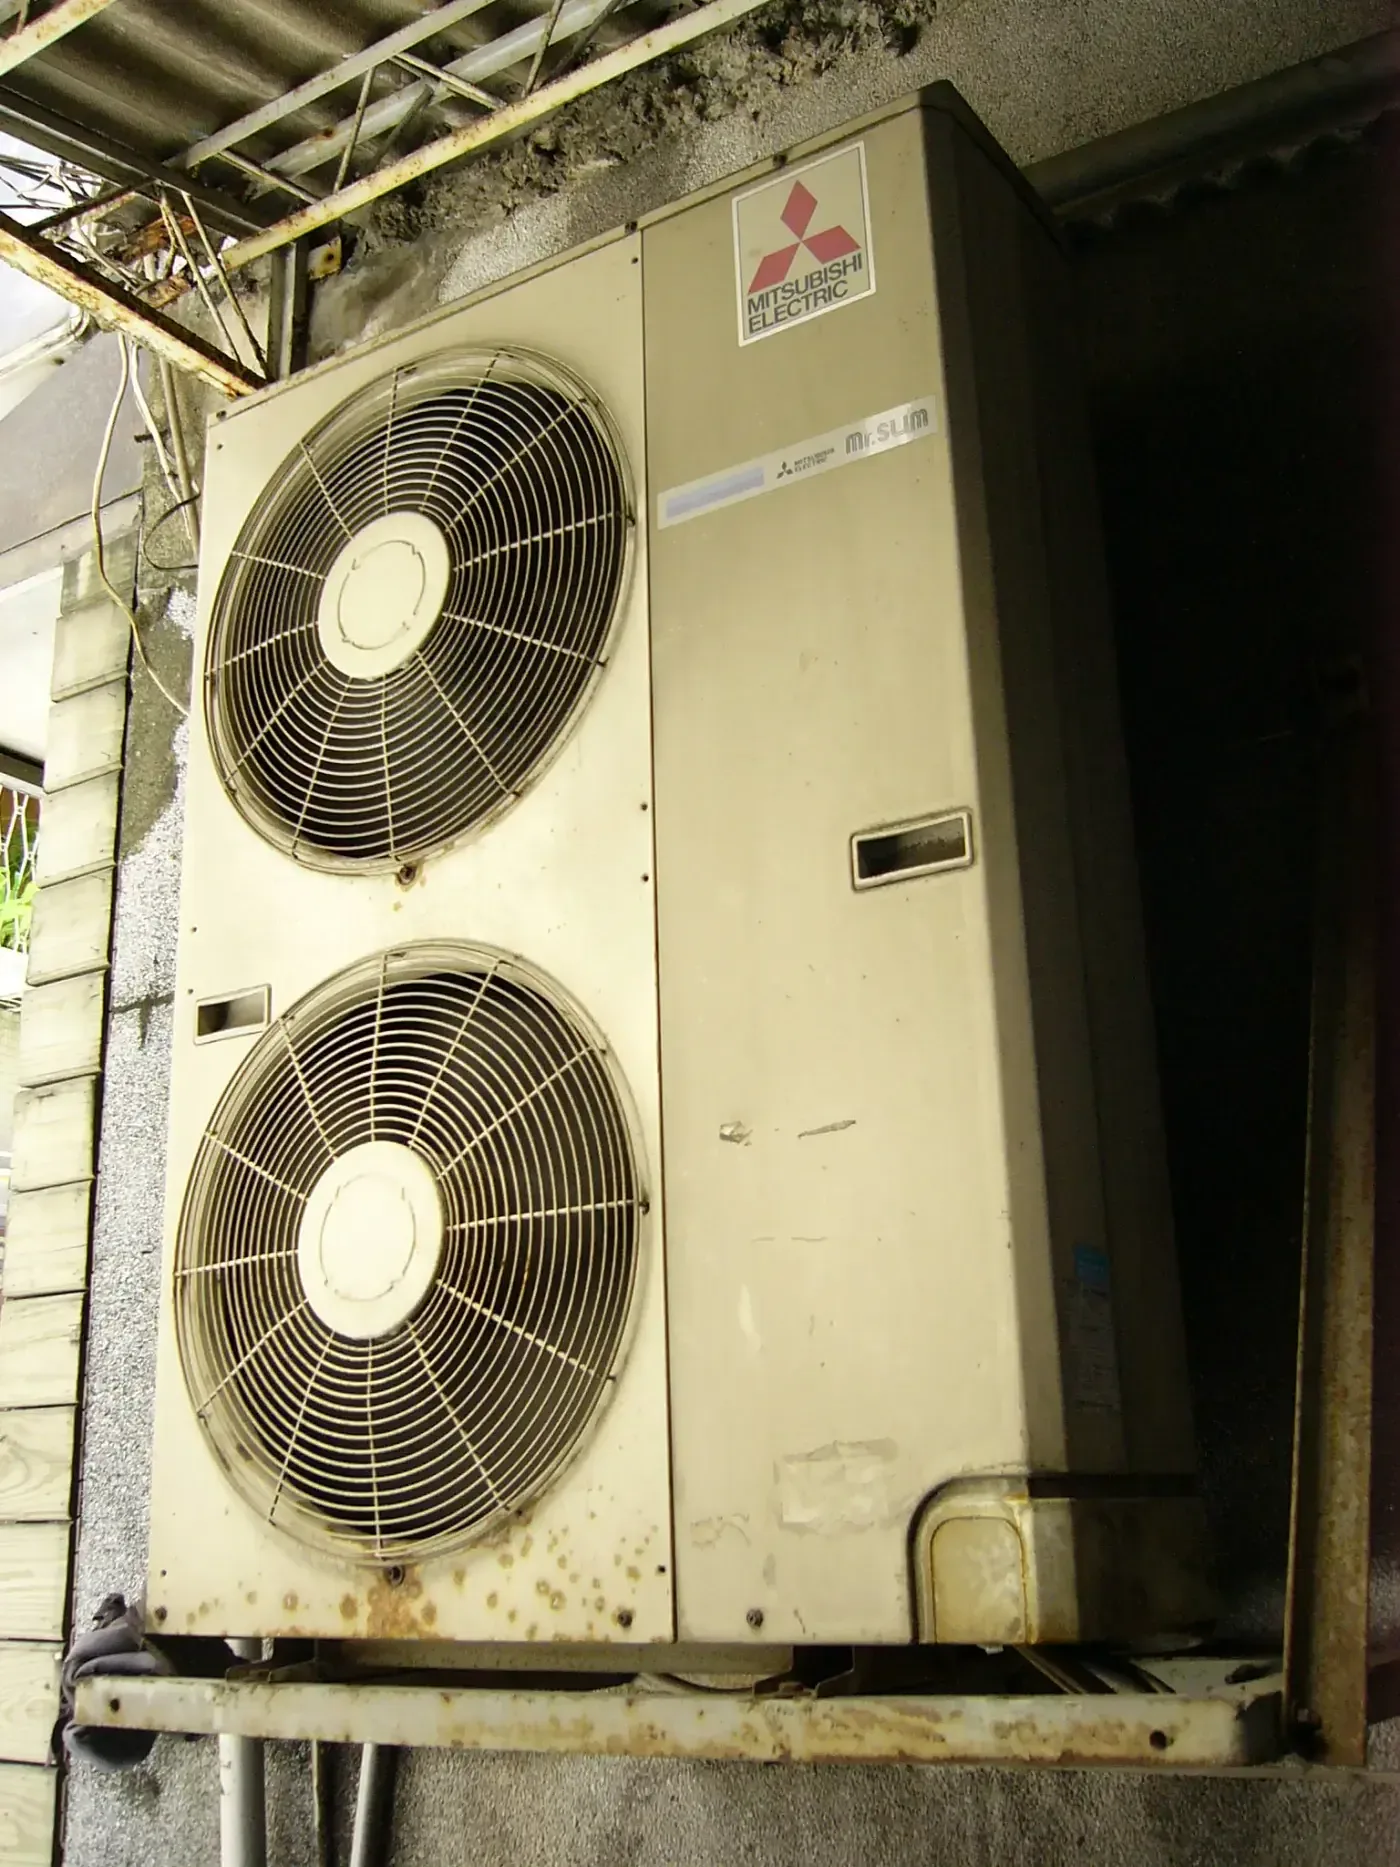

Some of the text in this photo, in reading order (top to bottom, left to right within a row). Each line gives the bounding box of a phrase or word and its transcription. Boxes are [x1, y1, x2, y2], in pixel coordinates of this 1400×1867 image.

[748, 253, 862, 315] MITSUBISHI
[749, 280, 848, 333] ELECTRIC
[794, 447, 834, 465] MITSU
